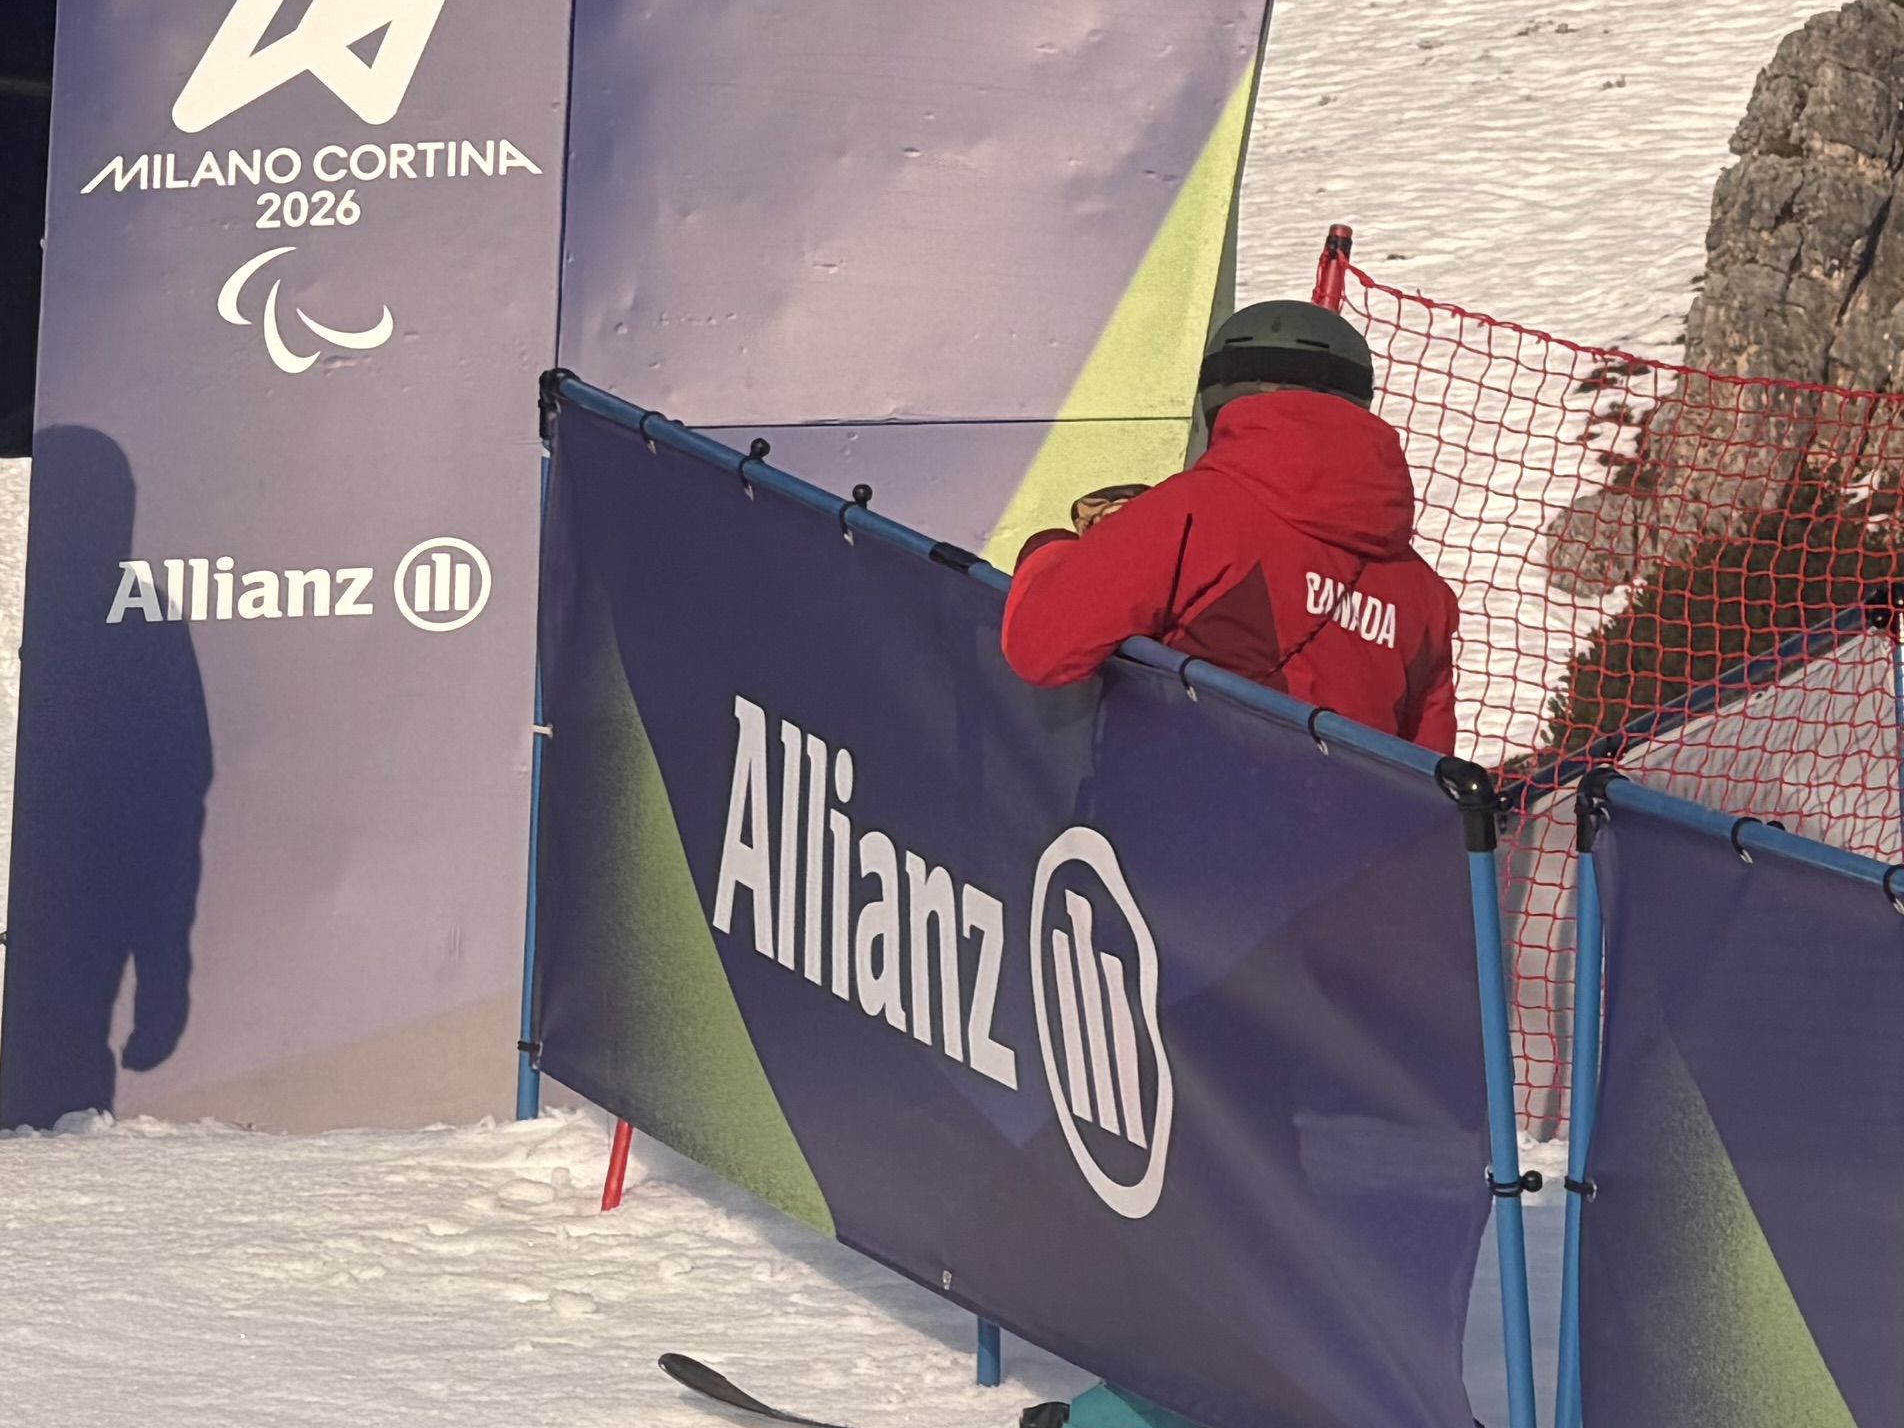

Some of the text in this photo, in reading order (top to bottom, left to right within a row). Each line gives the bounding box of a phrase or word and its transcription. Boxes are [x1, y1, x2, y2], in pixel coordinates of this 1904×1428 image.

[80, 139, 543, 195] MILANO CORTINA
[255, 188, 361, 229] 2026
[106, 556, 374, 623] Allianz
[1305, 571, 1396, 649] CANADA
[712, 694, 1019, 1091] Allianz
